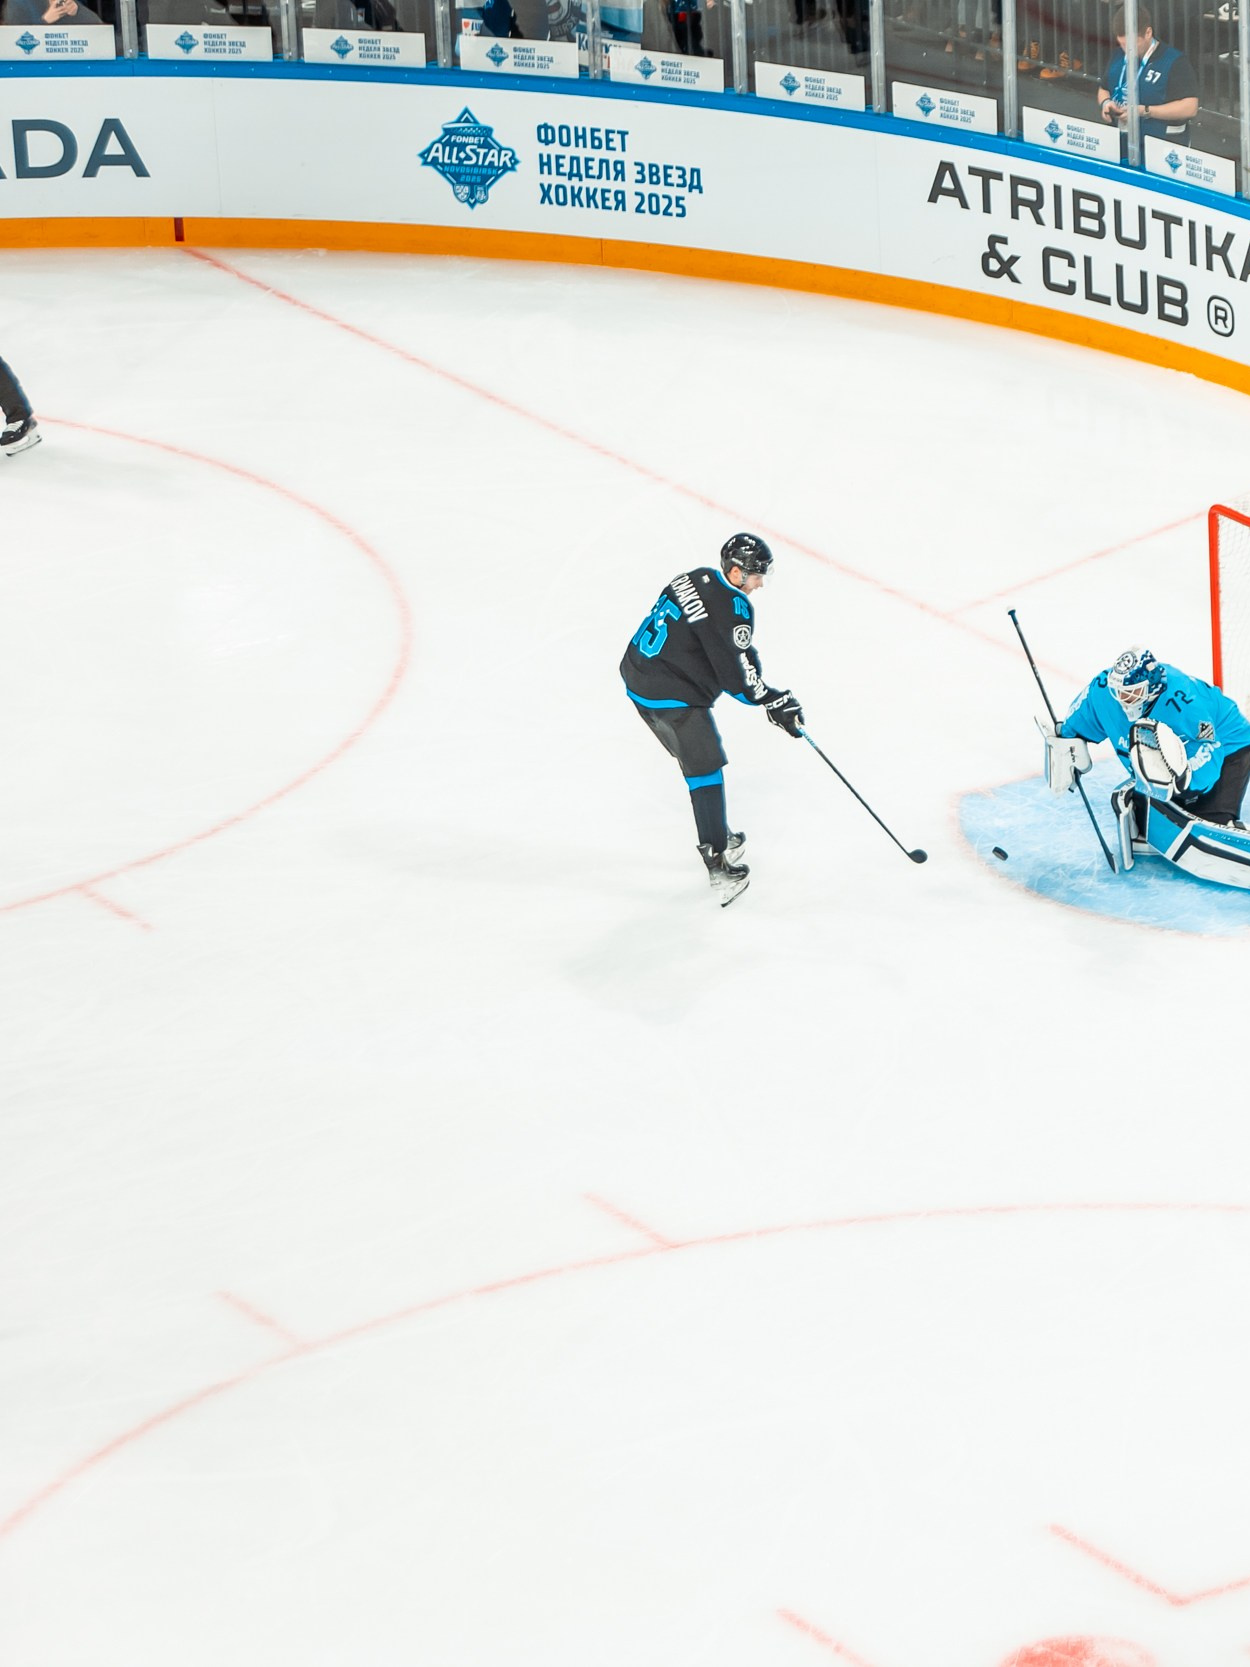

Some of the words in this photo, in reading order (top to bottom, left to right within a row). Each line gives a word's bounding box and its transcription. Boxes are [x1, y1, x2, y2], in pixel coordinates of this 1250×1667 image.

[1144, 69, 1161, 84] 57
[0, 118, 151, 179] DA
[451, 135, 485, 144] FONBET
[536, 122, 629, 153] ФОНБЕТ
[538, 153, 626, 182] НЕДЕЛЯ
[633, 161, 704, 194] ЗВЕЗД
[539, 183, 627, 212] ХОККЕЯ
[634, 191, 687, 218] 2025
[981, 235, 1022, 284] &
[1042, 246, 1189, 327] CLUB
[669, 573, 709, 623] RMAKOV
[1165, 689, 1194, 713] 72
